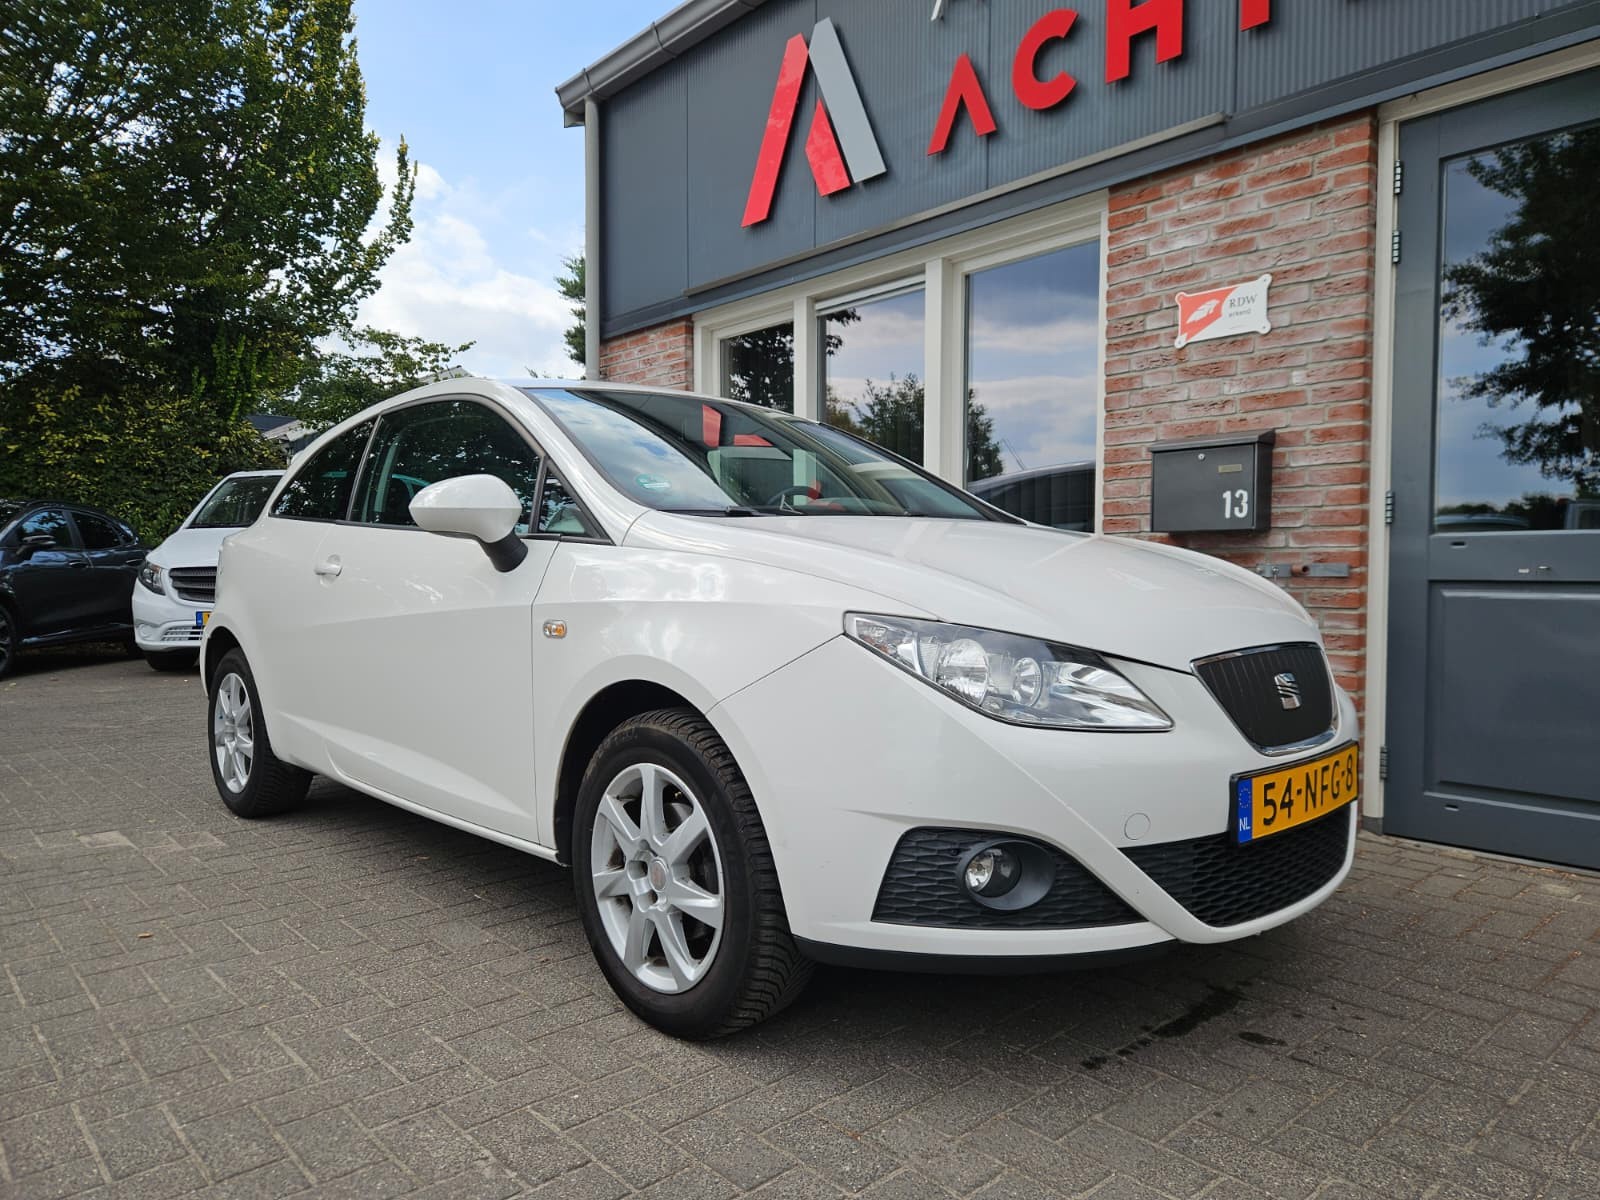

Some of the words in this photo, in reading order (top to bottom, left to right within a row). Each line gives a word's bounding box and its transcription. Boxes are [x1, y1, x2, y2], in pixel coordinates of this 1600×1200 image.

[1229, 294, 1258, 308] RDW
[1222, 489, 1248, 519] 13
[1263, 754, 1354, 826] 54-NFG-8
[1239, 817, 1251, 831] NL
